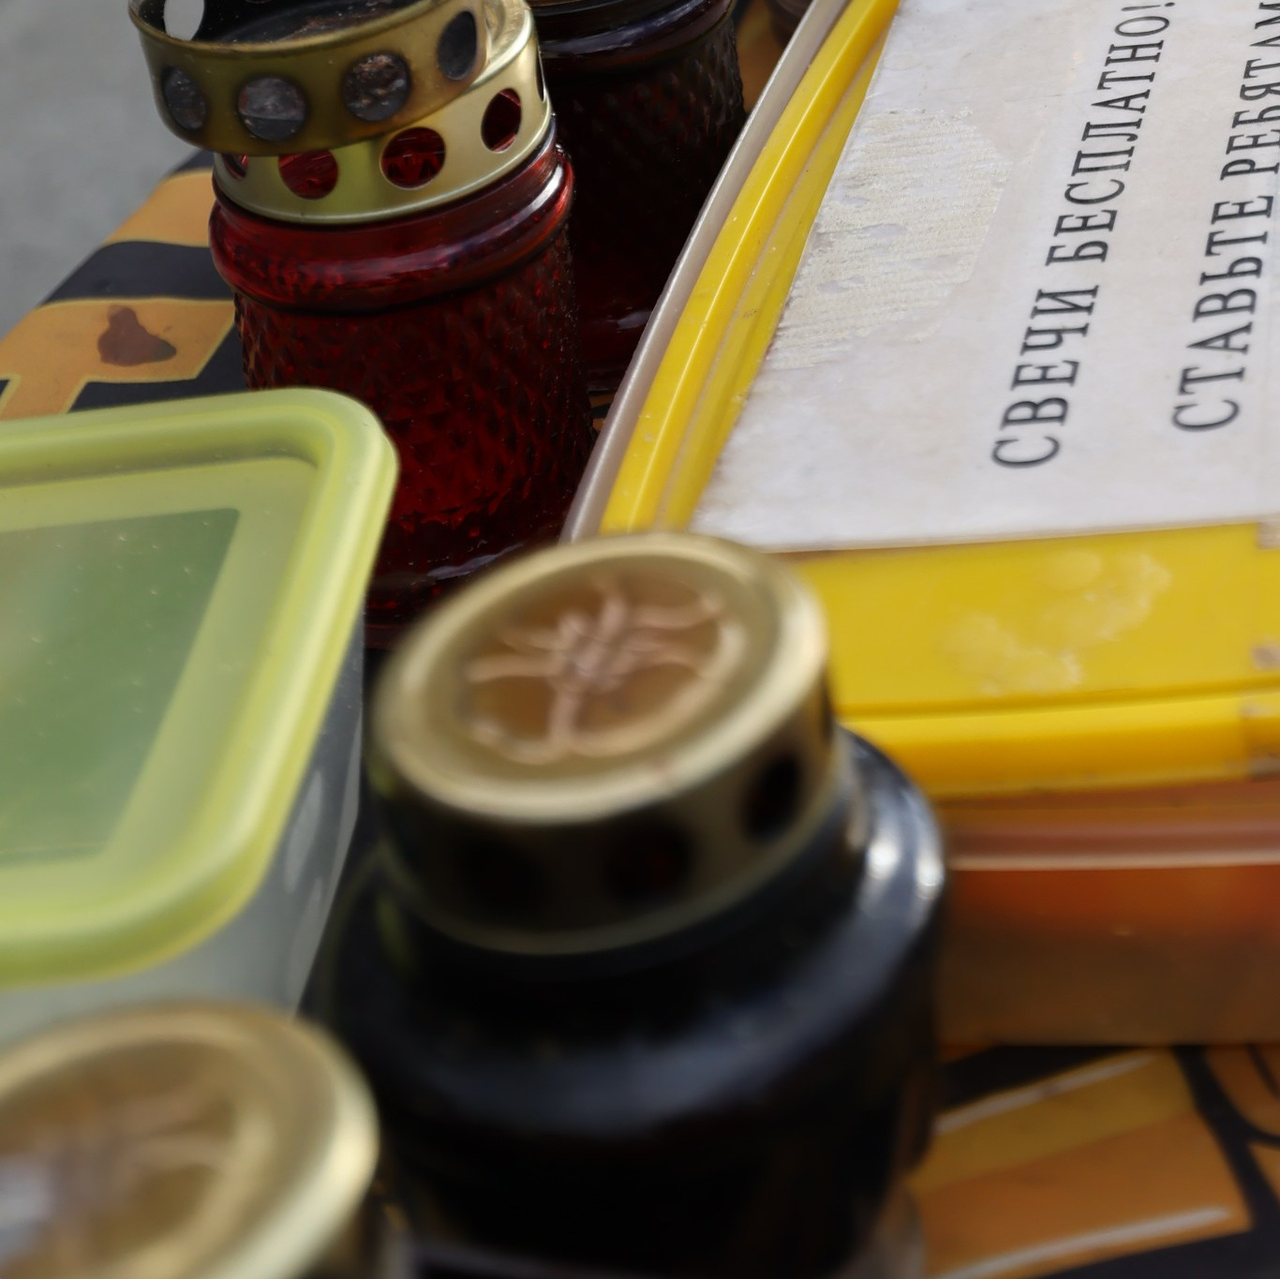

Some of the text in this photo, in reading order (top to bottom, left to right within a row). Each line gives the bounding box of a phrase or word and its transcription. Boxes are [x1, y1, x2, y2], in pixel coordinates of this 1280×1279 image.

[991, 1, 1176, 468] СВЕЧИ БЕСПЛАТНО!
[1172, 194, 1275, 433] СТАВЬТЕ
